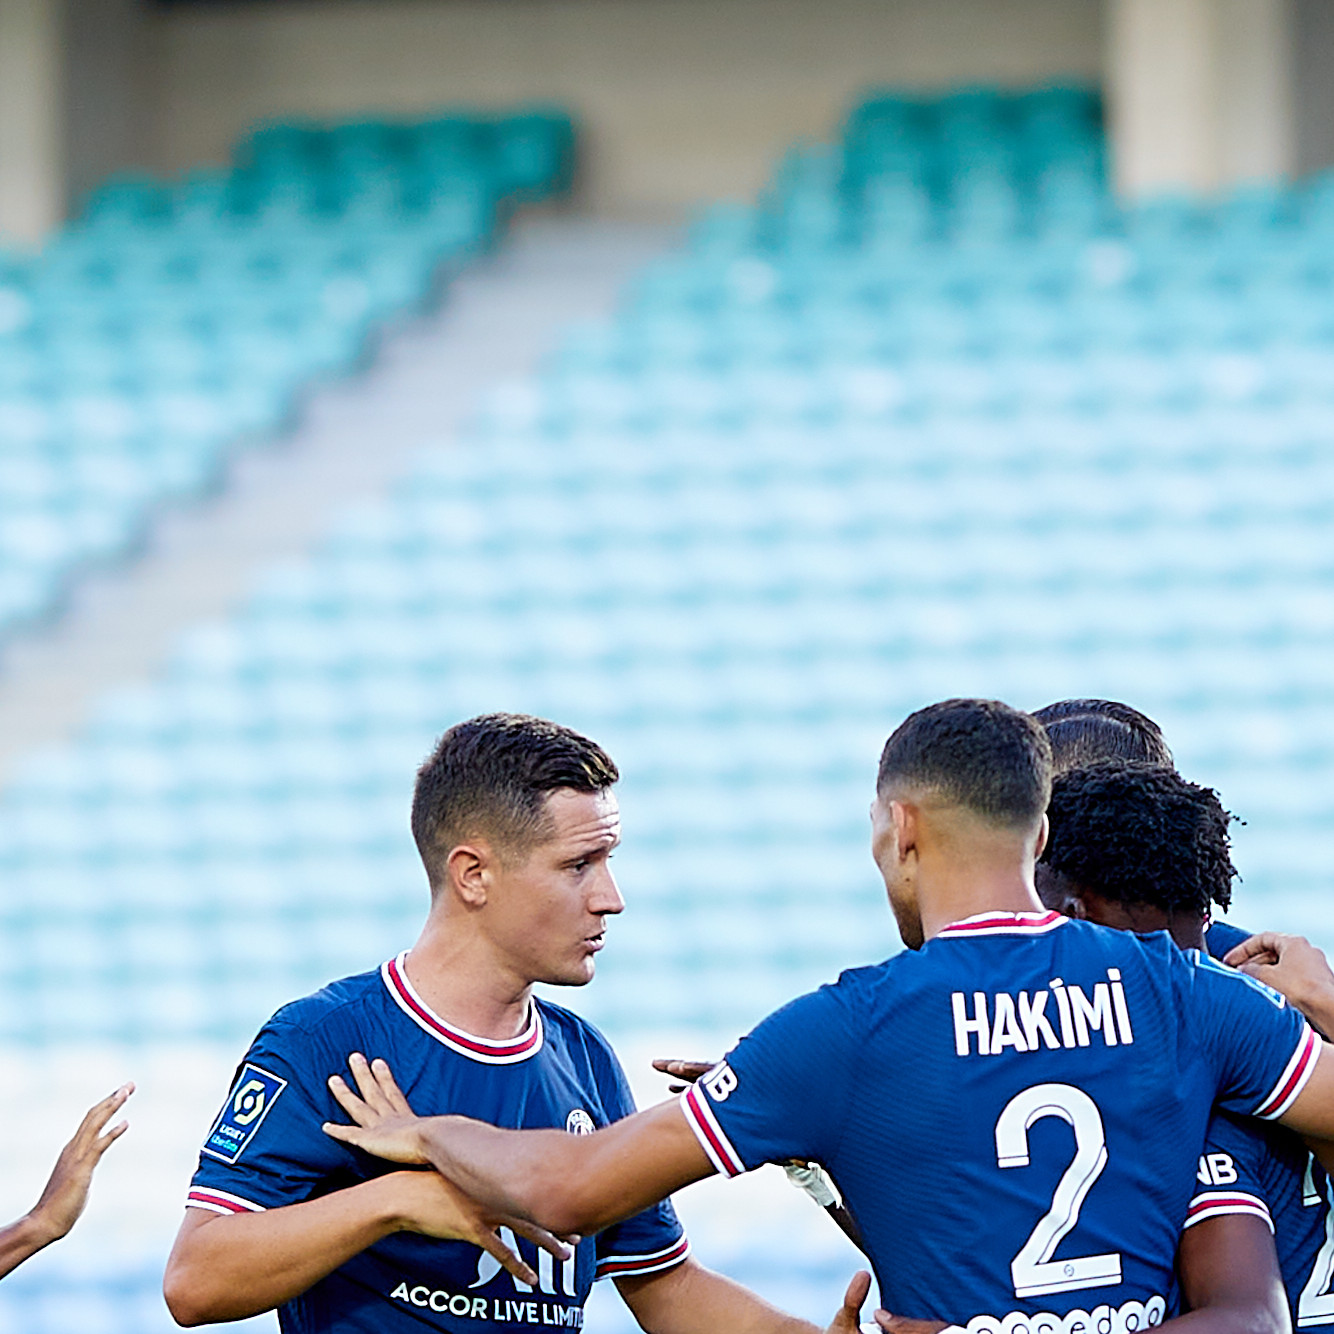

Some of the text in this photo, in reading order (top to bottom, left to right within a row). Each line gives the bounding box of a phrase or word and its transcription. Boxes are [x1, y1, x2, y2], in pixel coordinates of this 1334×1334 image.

[995, 1083, 1122, 1298] 2
[390, 1281, 488, 1320] ACCOR
[494, 1299, 539, 1324] LIVE
